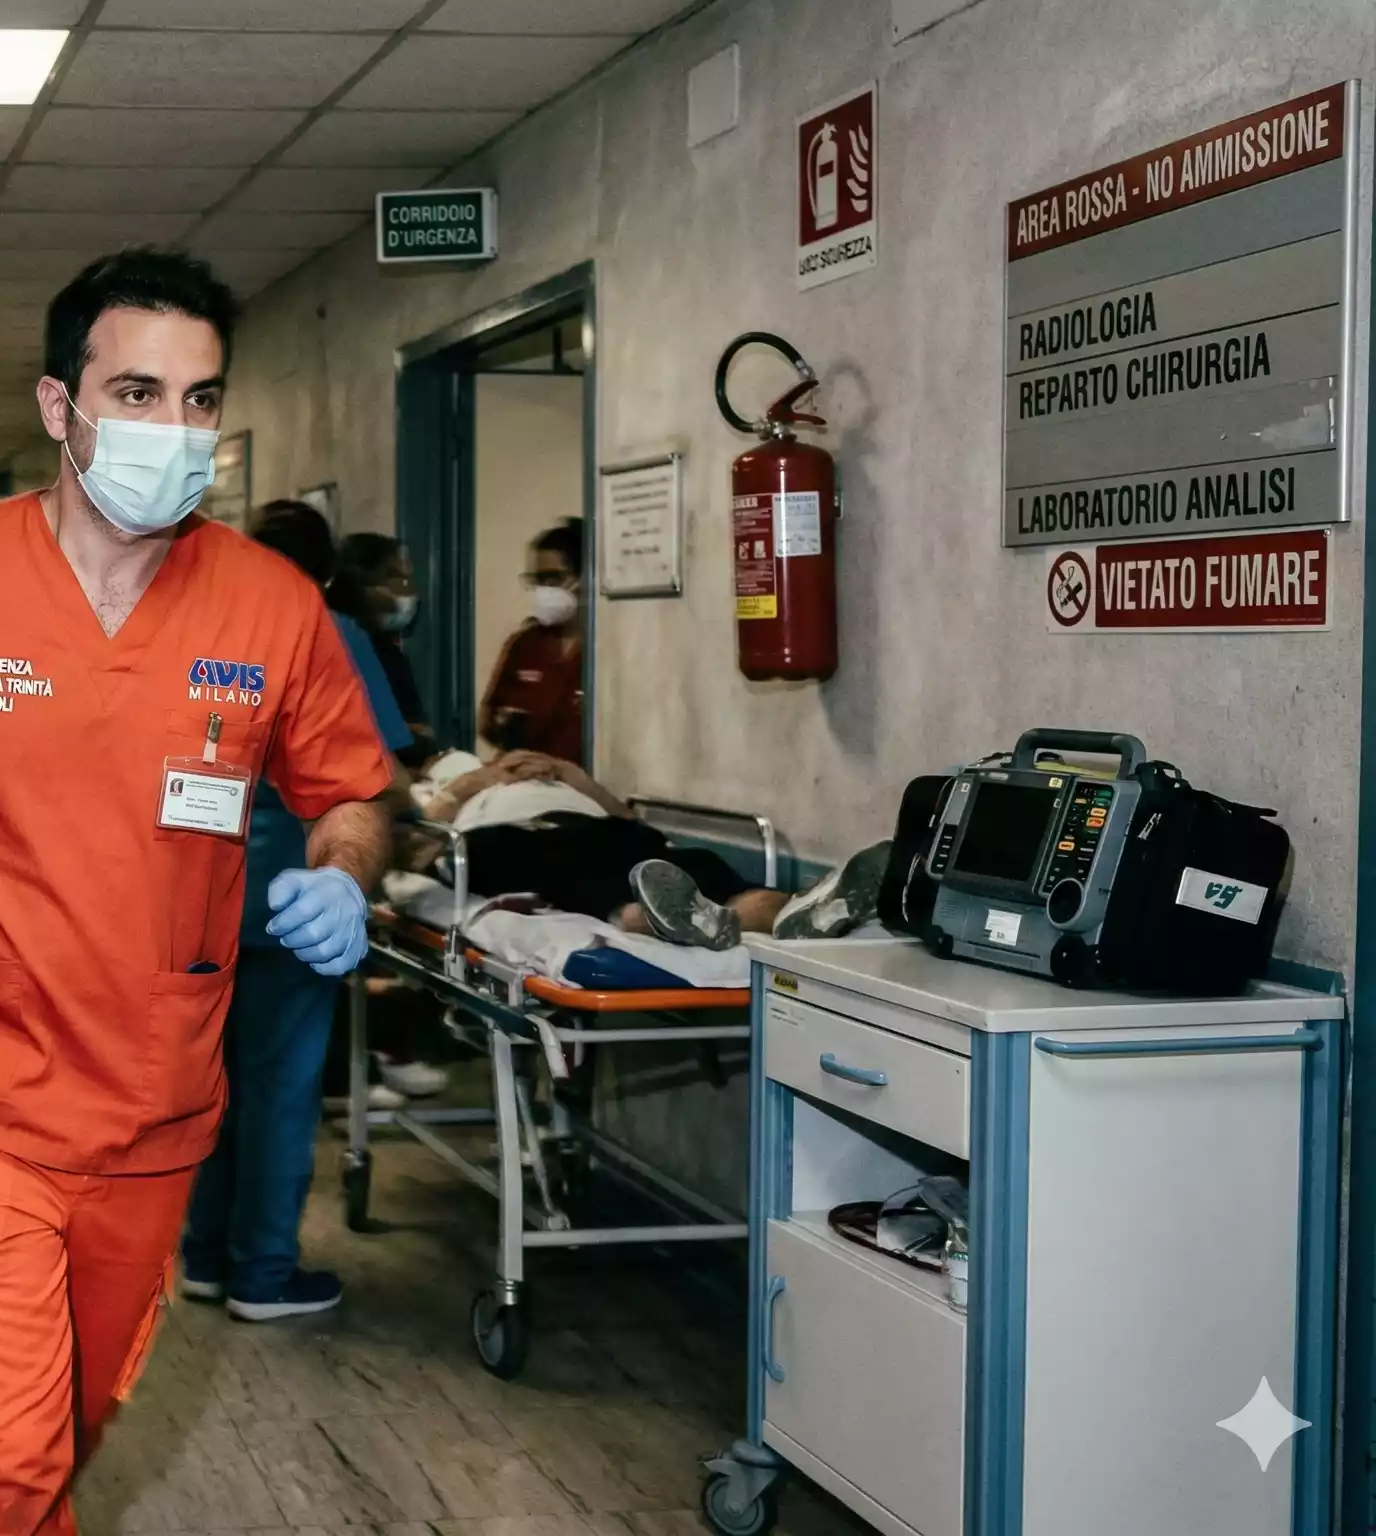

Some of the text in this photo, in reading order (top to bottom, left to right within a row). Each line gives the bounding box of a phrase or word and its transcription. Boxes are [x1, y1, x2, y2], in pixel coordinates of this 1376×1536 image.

[1017, 196, 1060, 246] AREA
[1065, 172, 1127, 231] ROSSA
[1146, 155, 1173, 203] NO
[1180, 100, 1330, 193] AMMISSIONE
[388, 227, 478, 248] D'URGENZA
[389, 204, 476, 224] CORRIDOIO
[1020, 292, 1157, 362] RADIOLOGIA
[1020, 332, 1271, 420] REPARTO CHIRURGIA
[1018, 467, 1295, 534] LABORATORIO ANALISI
[1101, 550, 1320, 611] VIETATO FUMARE
[6, 677, 53, 697] TRINITÀ
[188, 657, 265, 692] AVIS
[189, 686, 261, 706] MILANO
